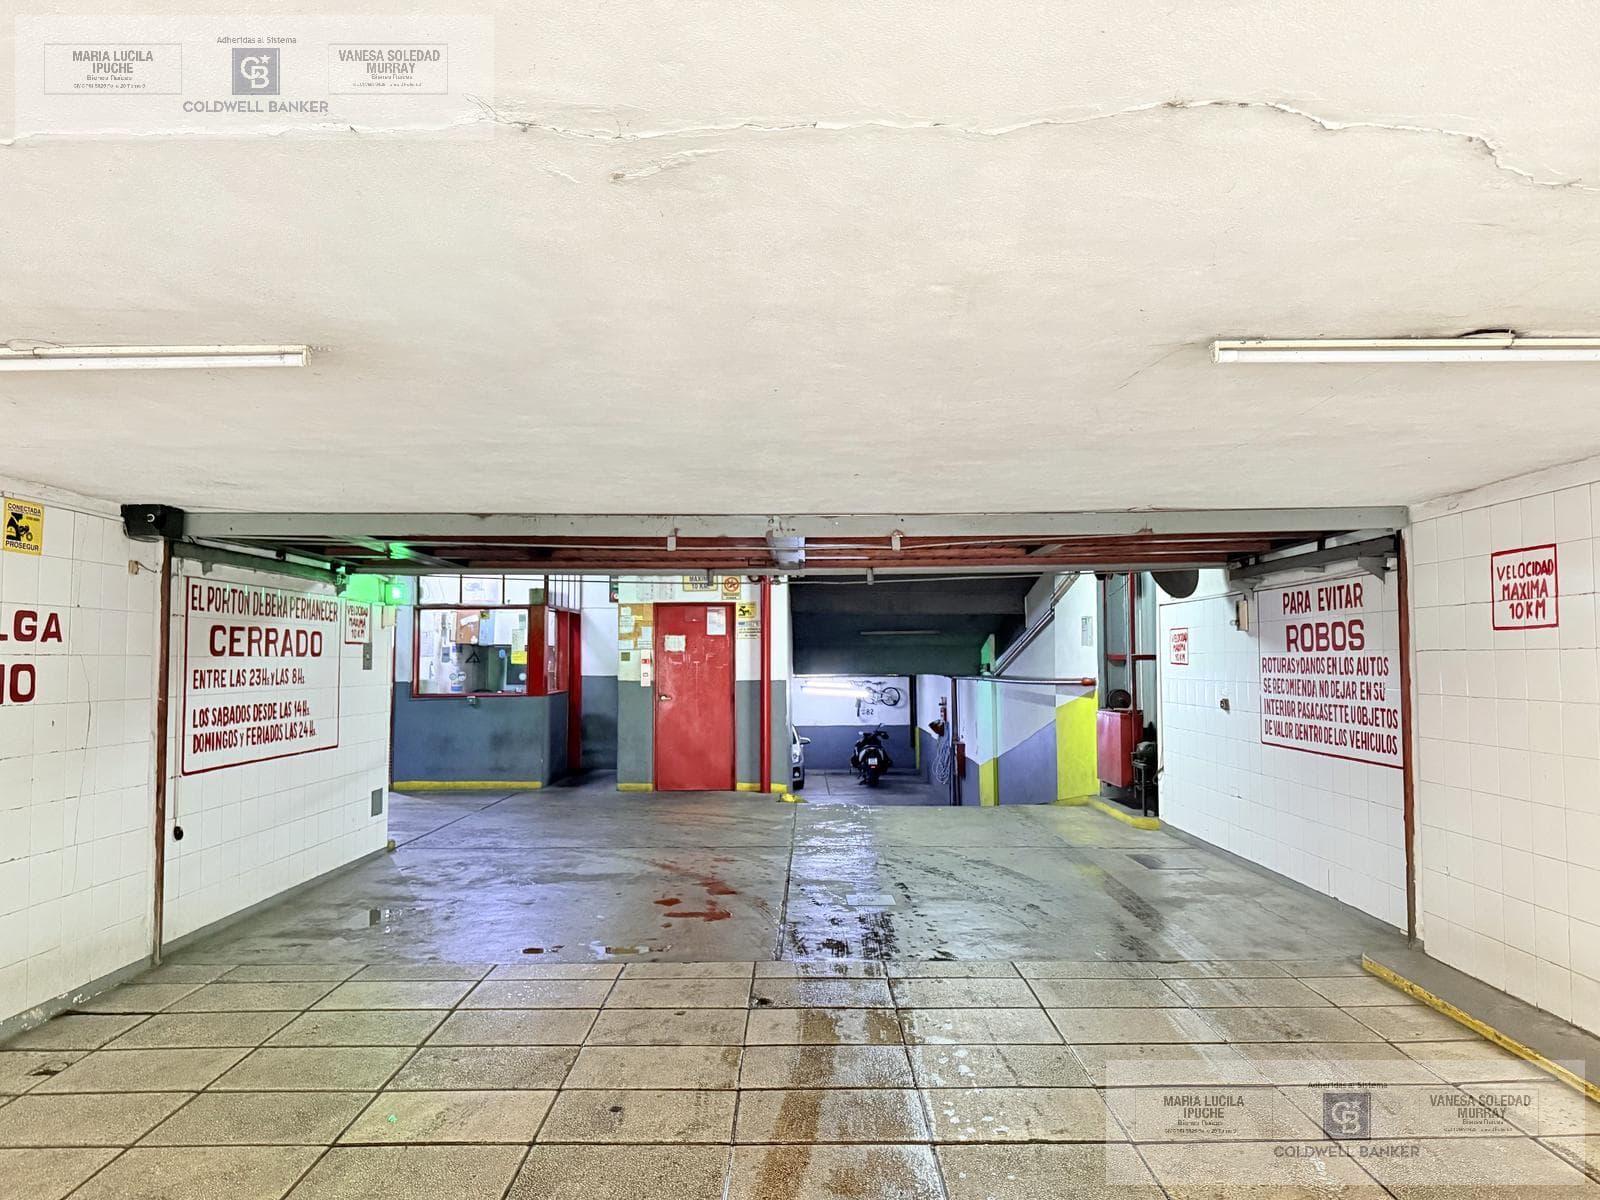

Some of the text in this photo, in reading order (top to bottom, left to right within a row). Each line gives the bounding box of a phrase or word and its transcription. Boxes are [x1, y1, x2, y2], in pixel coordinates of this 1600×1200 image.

[7, 502, 41, 514] CONECTADA
[5, 540, 40, 551] PROSEGUR
[1496, 558, 1554, 581] VELOCIDAD
[1282, 582, 1364, 615] PARA EVITAR
[1502, 578, 1549, 601] MAXIMA
[191, 584, 339, 623] EL PORTON DEBERA PERMANECER
[209, 624, 323, 658] CERRADO
[1286, 619, 1365, 653] ROBOS
[193, 669, 227, 689] ENTRE
[229, 669, 247, 688] LAS
[275, 668, 289, 685] LAS
[1261, 657, 1296, 674] ROTURAS
[1326, 657, 1338, 676] EN
[1340, 656, 1354, 676] LOS
[1356, 656, 1389, 677] AUTOS
[1263, 677, 1386, 702] SE RECOMIENDA NO DEJAR EN SU
[192, 707, 209, 728] LOS
[211, 705, 251, 727] SABADOS
[253, 702, 277, 722] DESDE
[279, 701, 292, 719] LAS
[1263, 698, 1296, 718] INTERIOR
[1297, 701, 1349, 724] PASACASETTE
[1356, 706, 1399, 730] OBJETOS
[192, 729, 238, 754] DOMINGOS
[246, 723, 283, 746] FERIADOS
[284, 722, 298, 742] LAS
[1264, 719, 1398, 756] DE VALOR DENTRO DE LOS VEHICULOS
